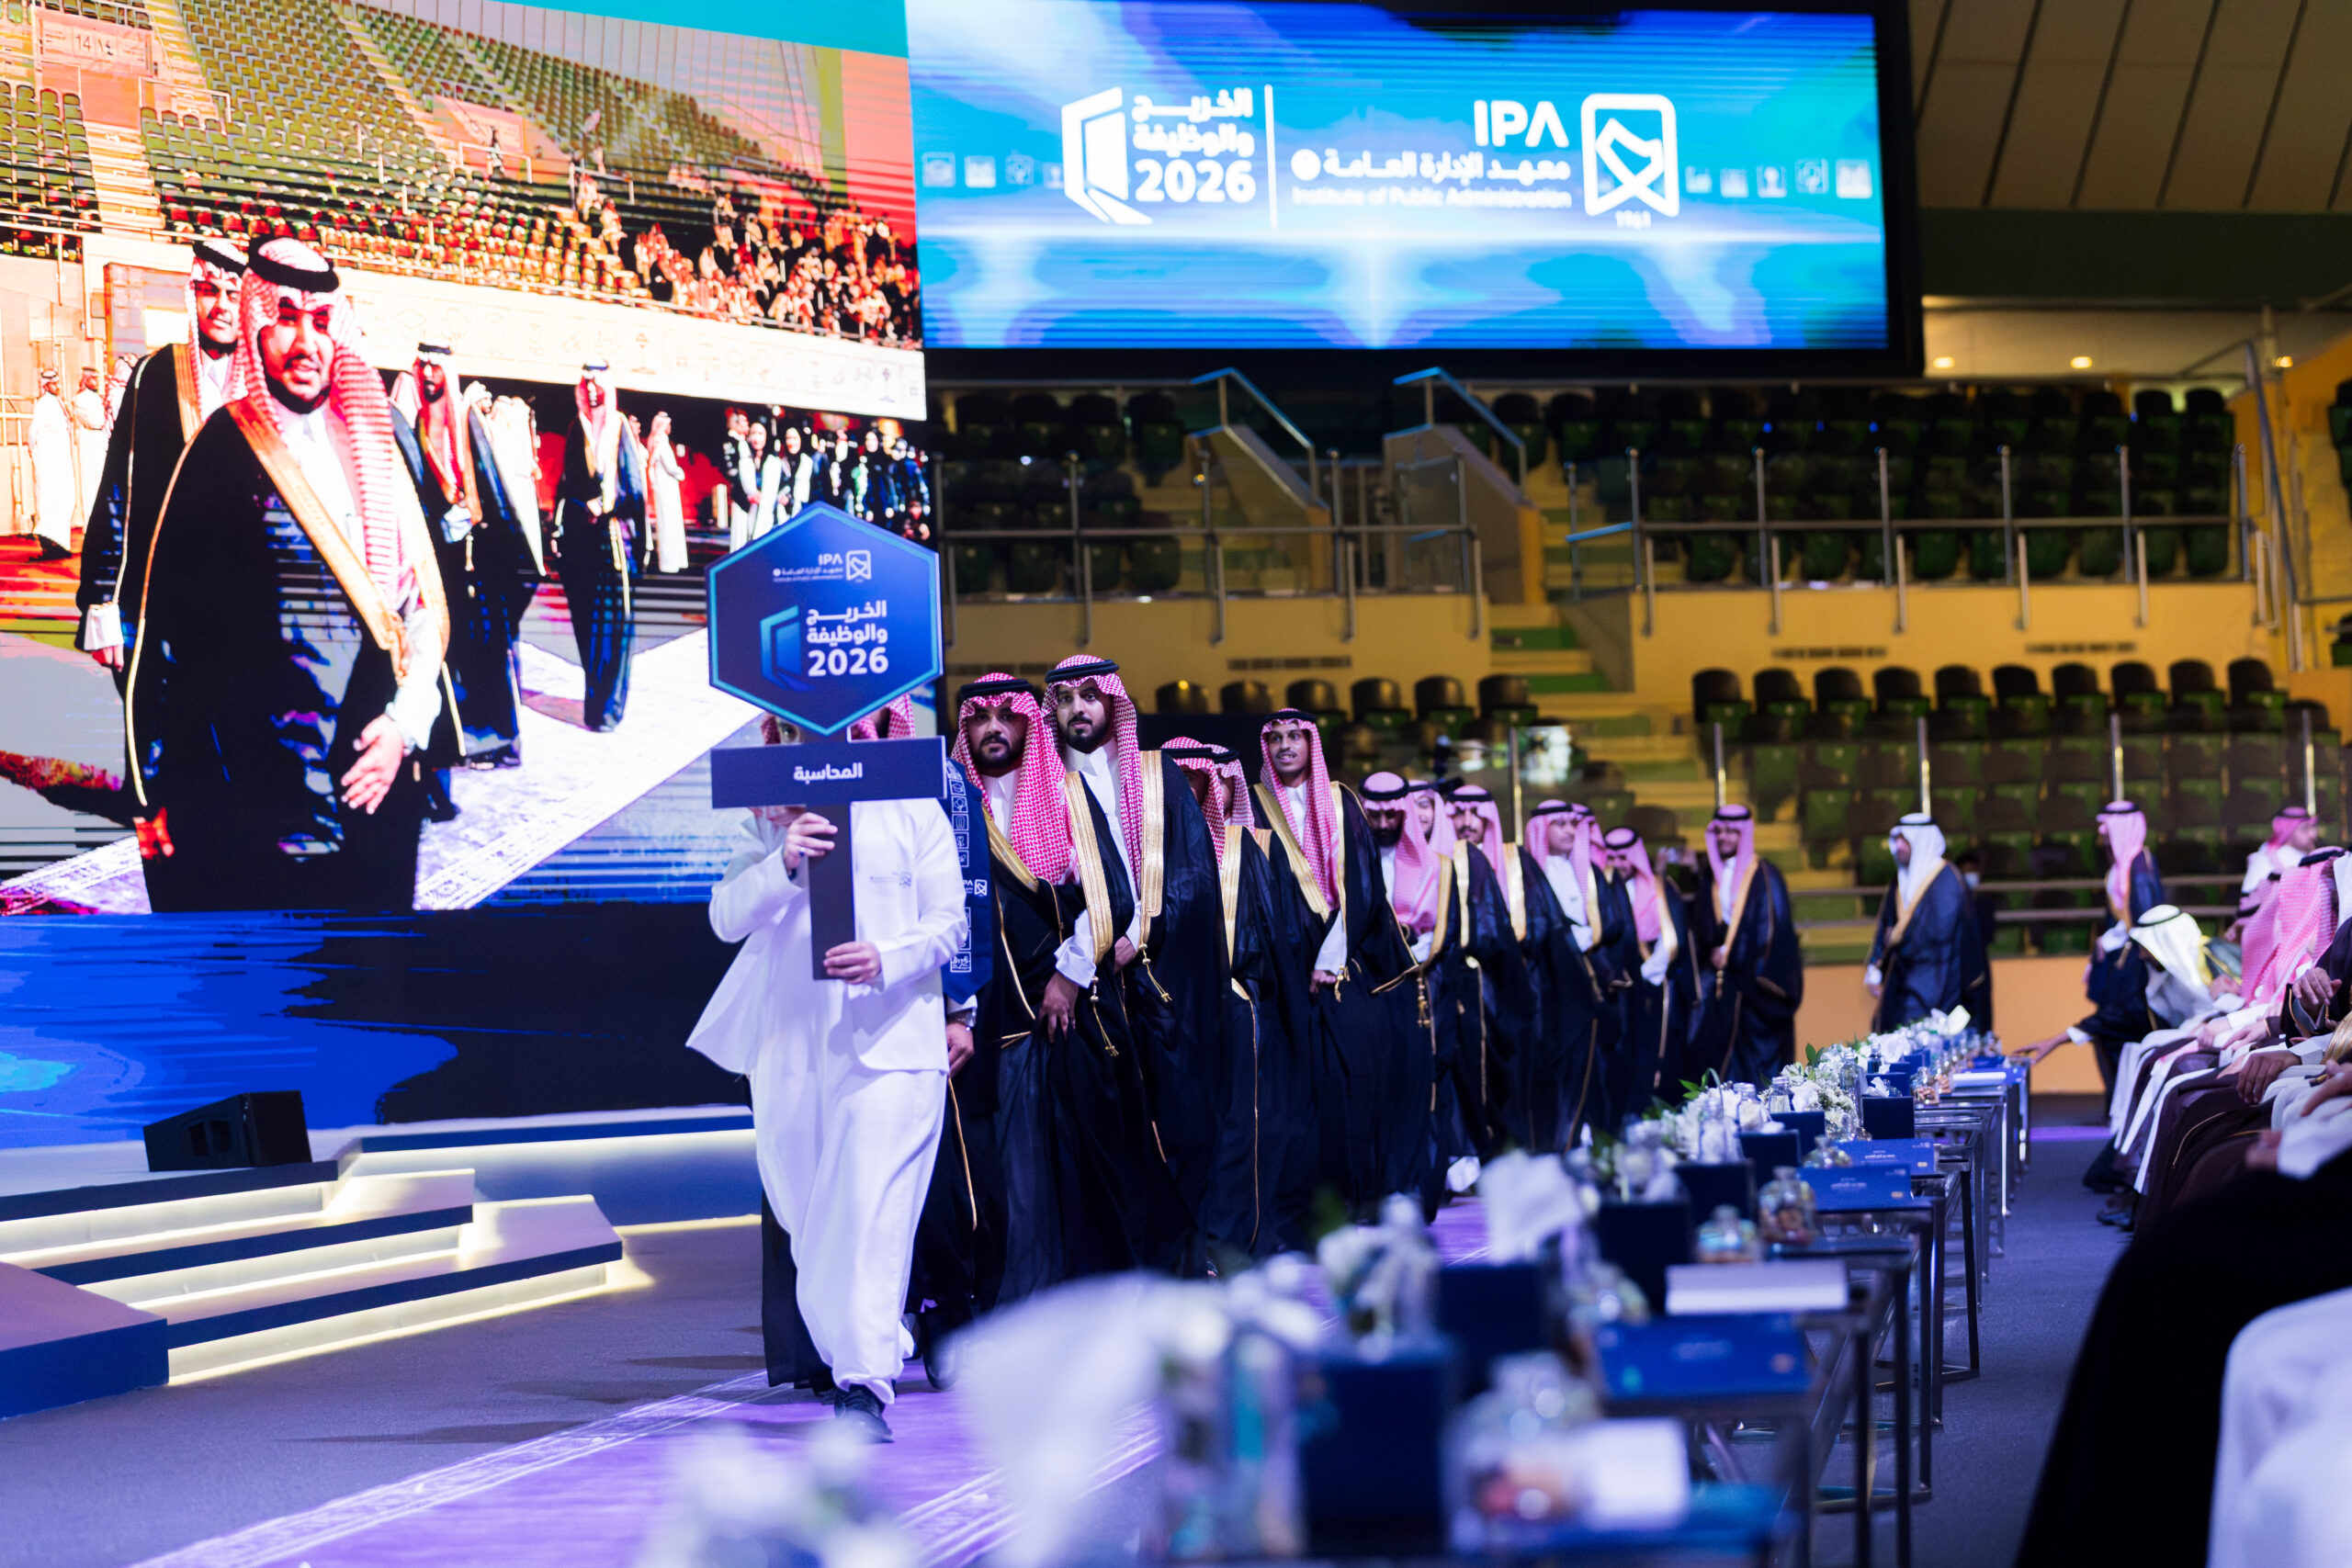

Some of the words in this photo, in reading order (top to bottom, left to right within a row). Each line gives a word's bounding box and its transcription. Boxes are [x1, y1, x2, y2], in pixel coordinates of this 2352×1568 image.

[1132, 87, 1253, 122] الخريج
[1474, 99, 1569, 148] IPA
[1133, 122, 1255, 157] والوظيفة
[1323, 148, 1417, 178] العامة
[1487, 159, 1571, 186] معهد
[1135, 159, 1257, 203] 2026
[819, 553, 843, 566] IPA
[807, 600, 888, 626] الخريج
[807, 624, 888, 646] والوظيفة
[808, 647, 888, 677] 2026
[793, 762, 863, 784] المحاسبة
